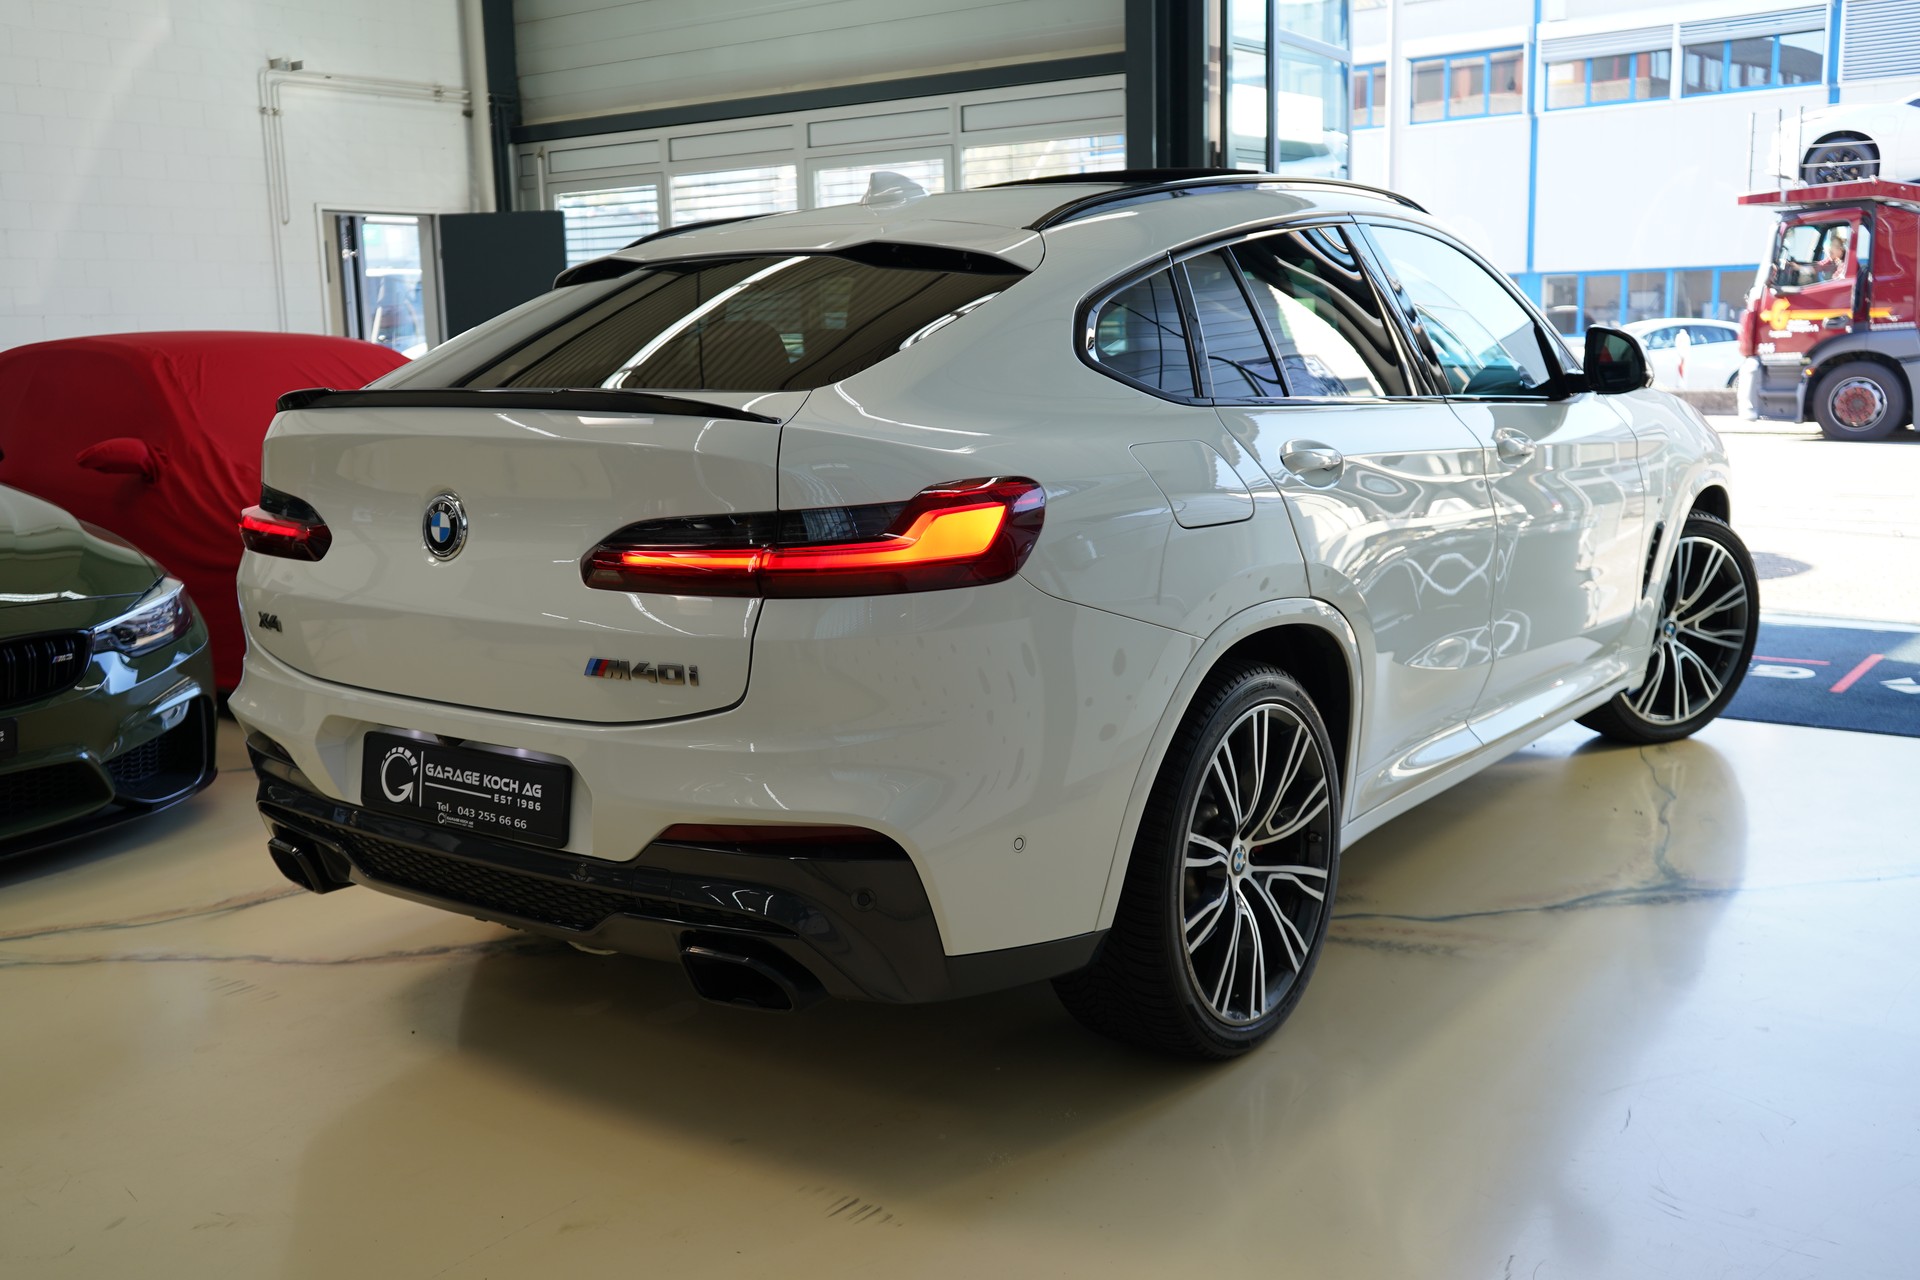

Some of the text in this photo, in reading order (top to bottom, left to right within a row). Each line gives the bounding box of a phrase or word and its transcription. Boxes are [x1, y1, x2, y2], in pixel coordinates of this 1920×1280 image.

[429, 503, 457, 520] BMW
[258, 611, 283, 633] X4
[601, 658, 699, 686] M40i
[425, 763, 542, 798] GARAGE KOCH AG
[493, 793, 541, 811] EST 1986
[436, 801, 527, 829] Tel. 043 255 66 66
